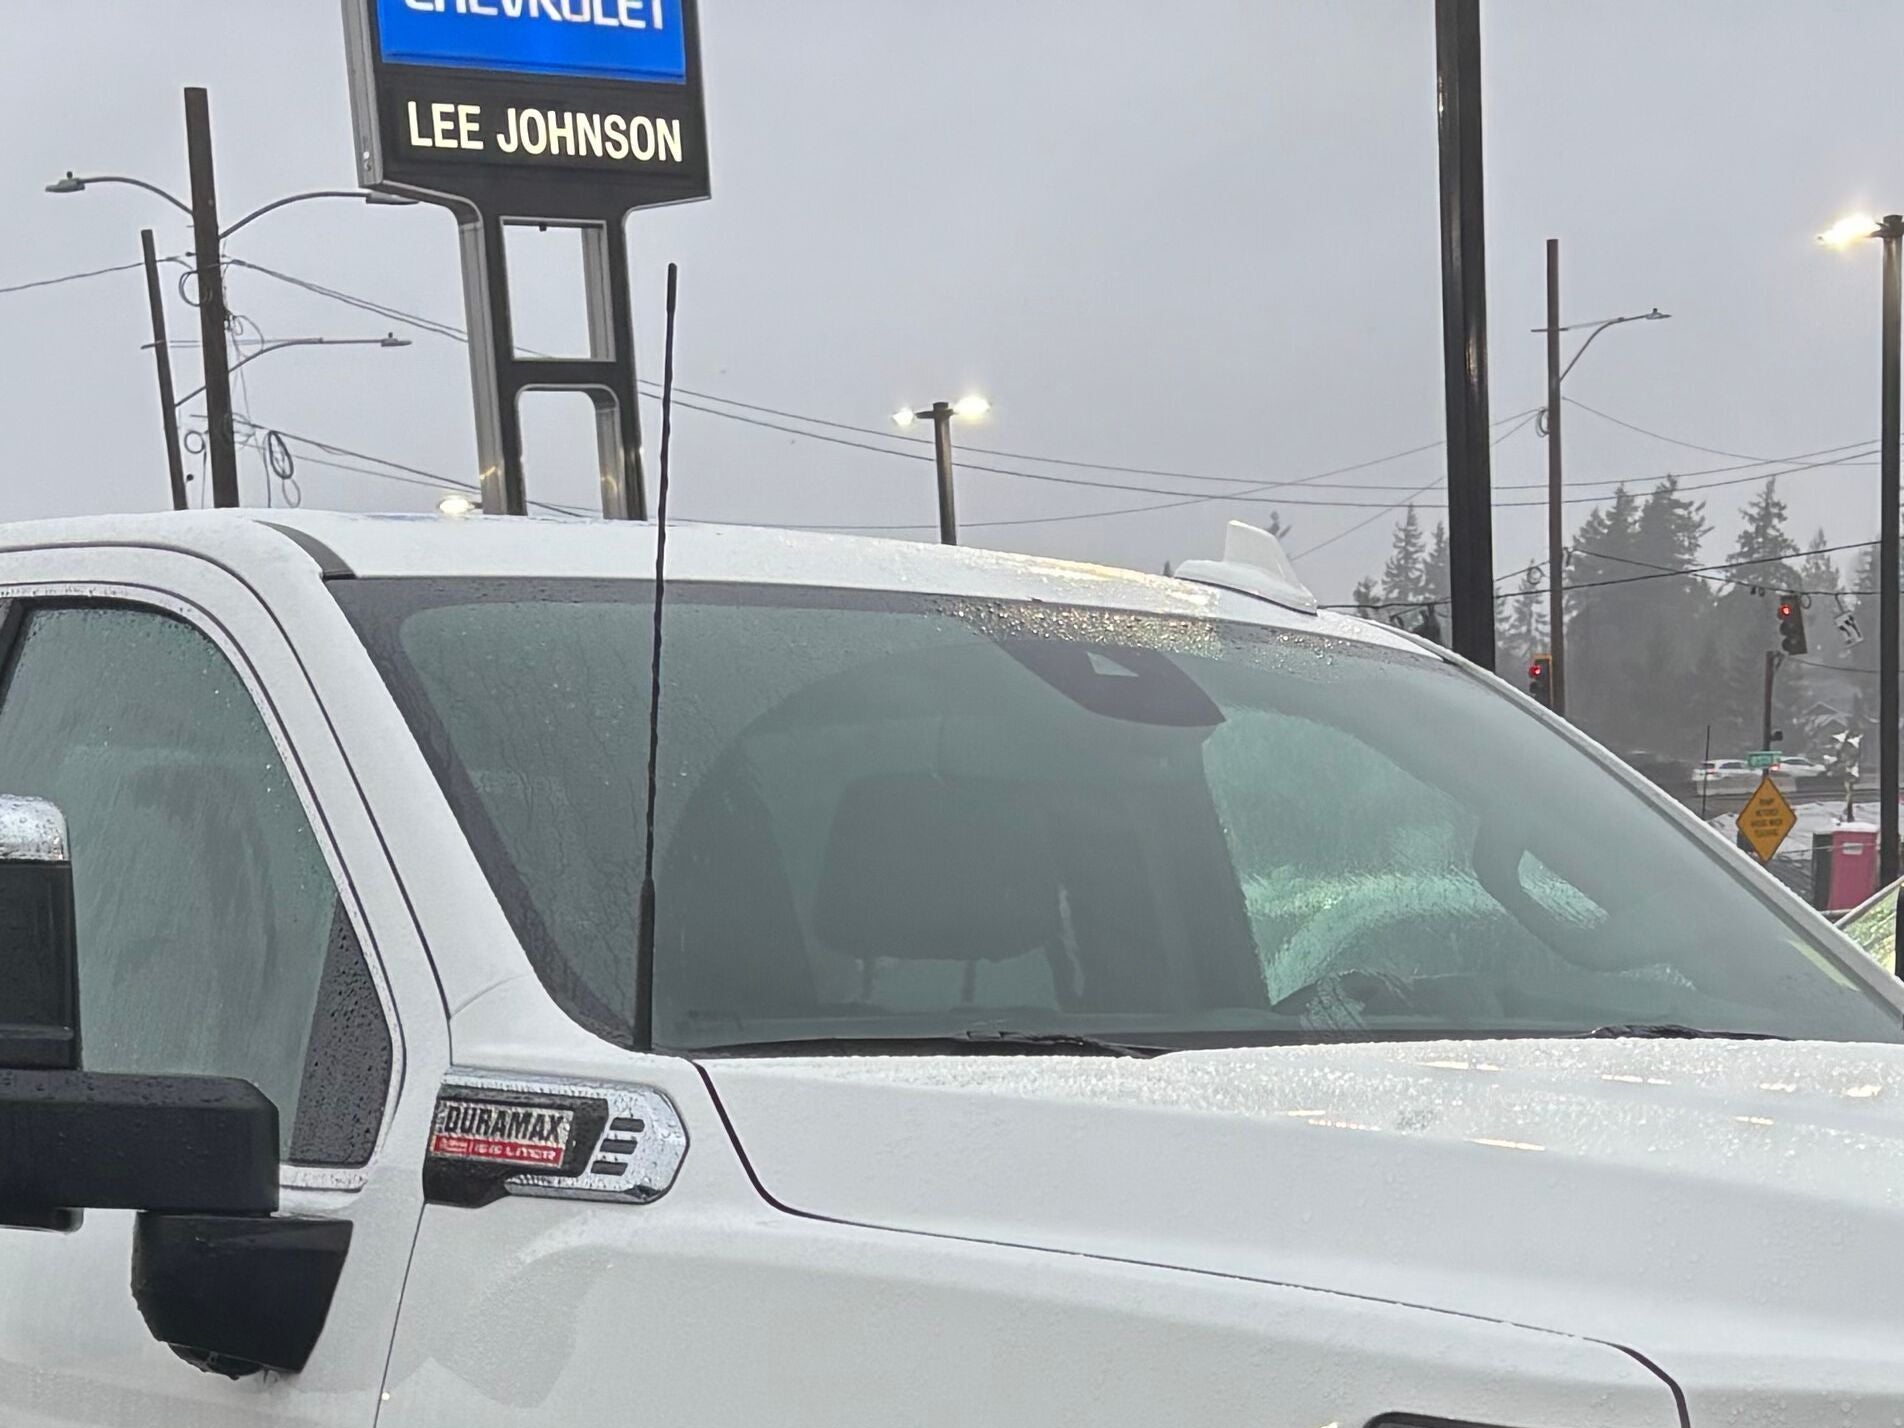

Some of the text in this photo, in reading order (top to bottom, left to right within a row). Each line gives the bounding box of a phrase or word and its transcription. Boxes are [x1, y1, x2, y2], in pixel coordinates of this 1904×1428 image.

[407, 101, 683, 162] LEE JOHNSON
[443, 1105, 565, 1145] DURAMAX
